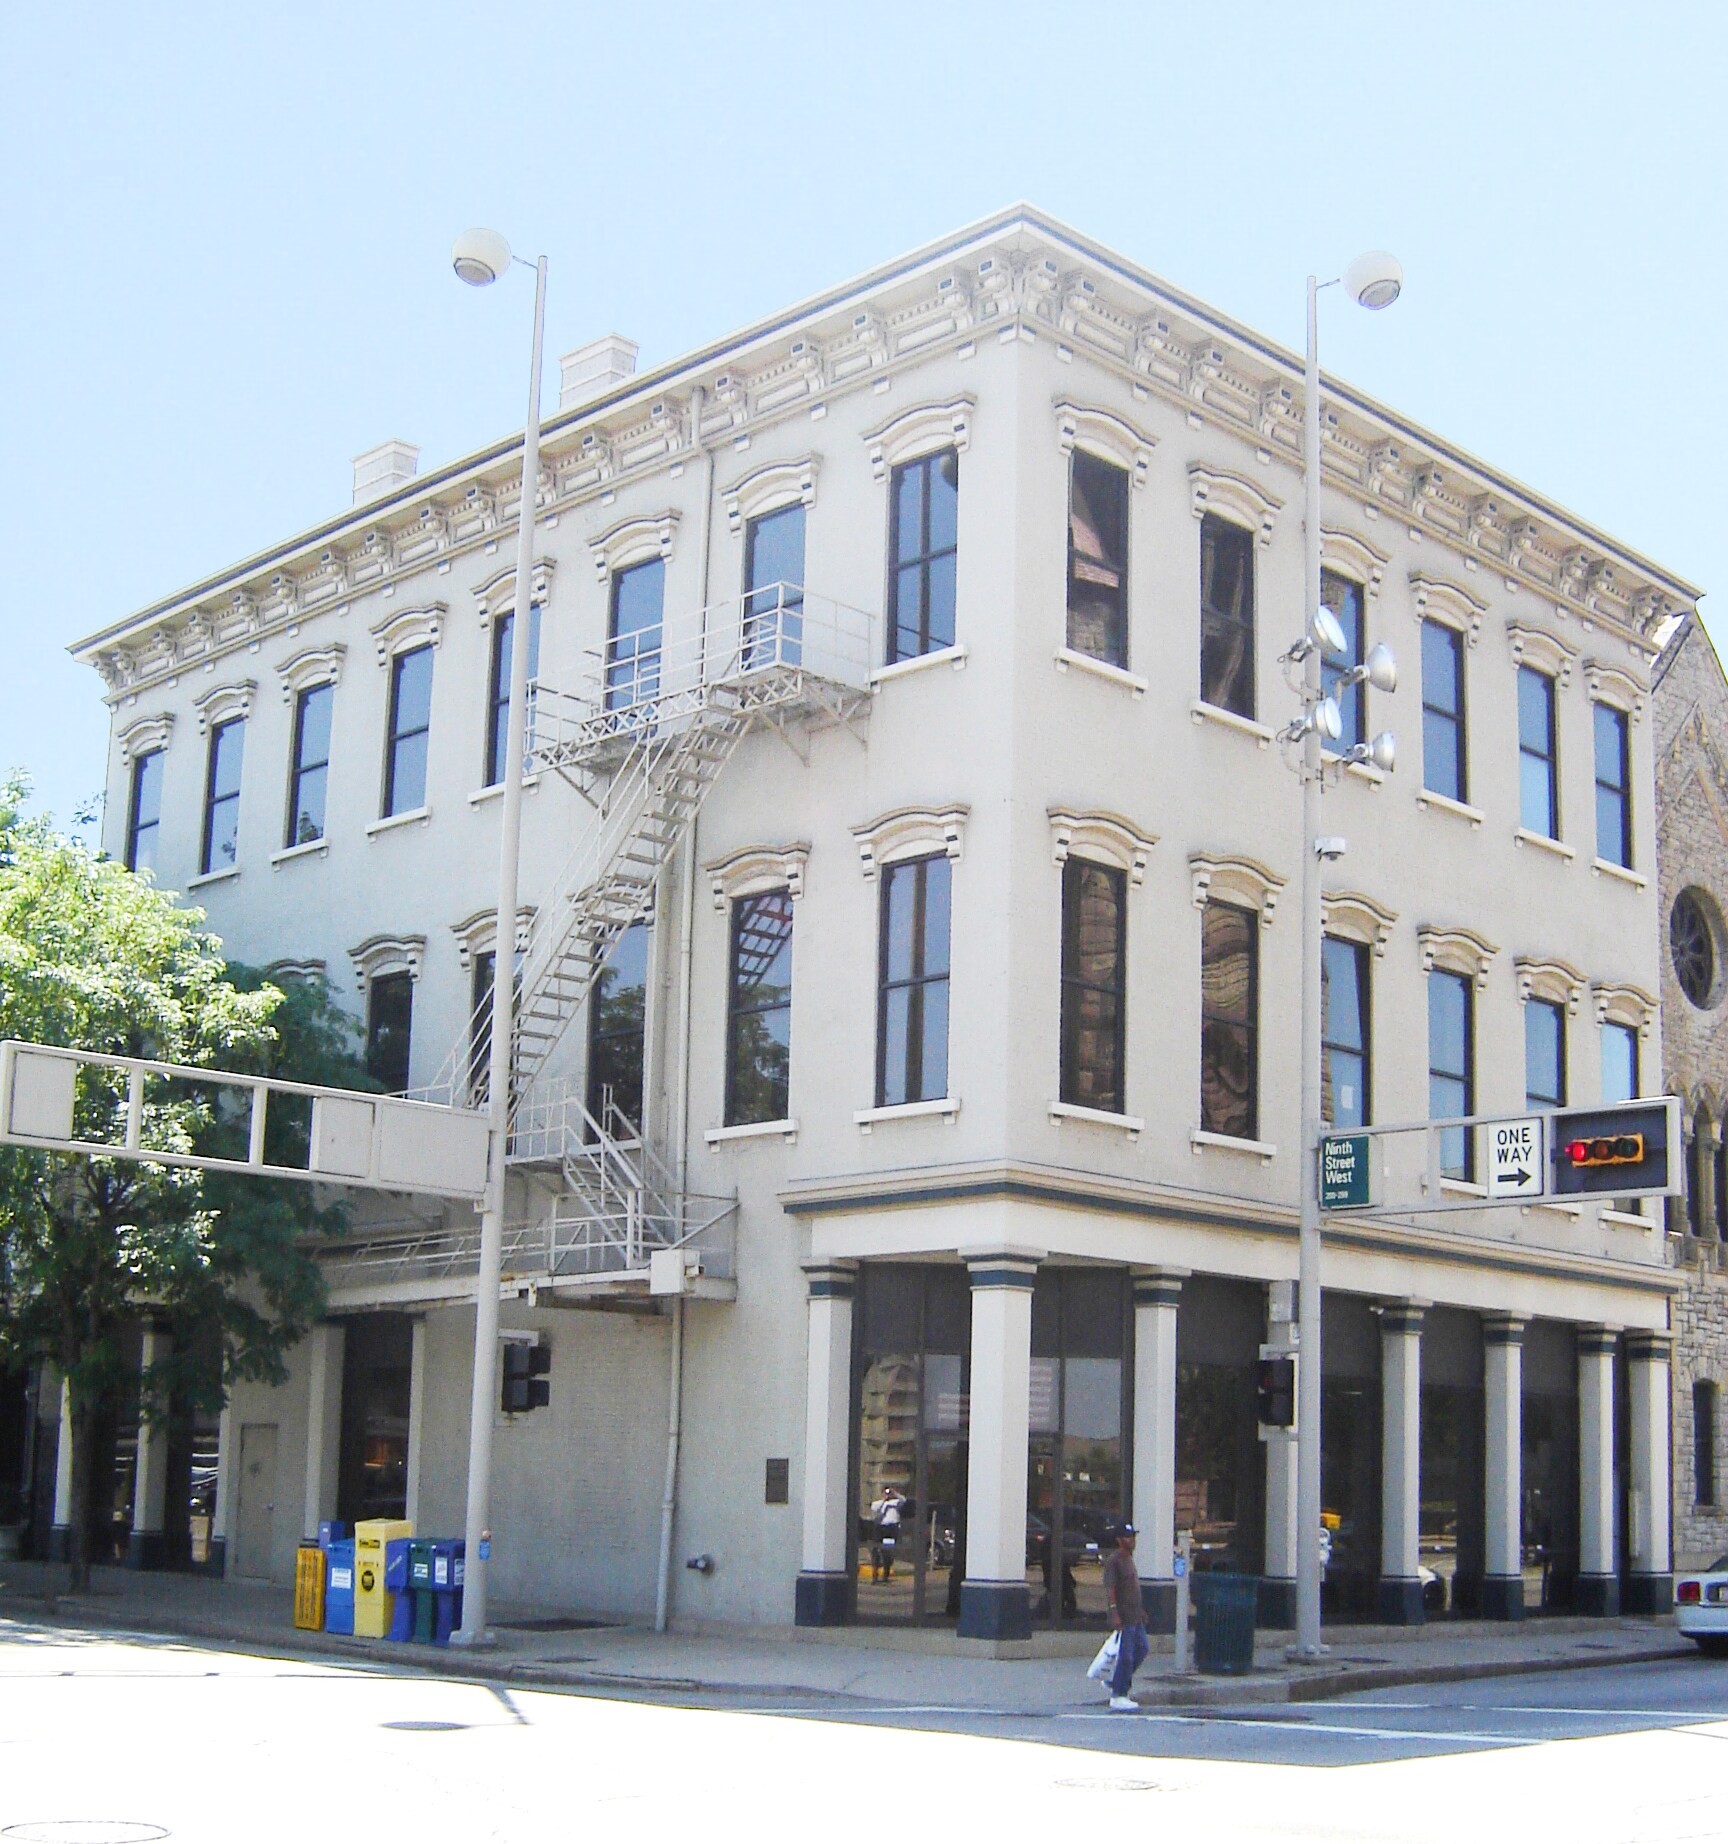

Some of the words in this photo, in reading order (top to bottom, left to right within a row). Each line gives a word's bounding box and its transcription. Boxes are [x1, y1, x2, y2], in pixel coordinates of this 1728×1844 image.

[1497, 1127, 1531, 1145] ONE
[1325, 1141, 1352, 1155] Ninth
[1497, 1146, 1533, 1163] WAY
[1325, 1156, 1355, 1170] Street
[1325, 1171, 1352, 1184] West
